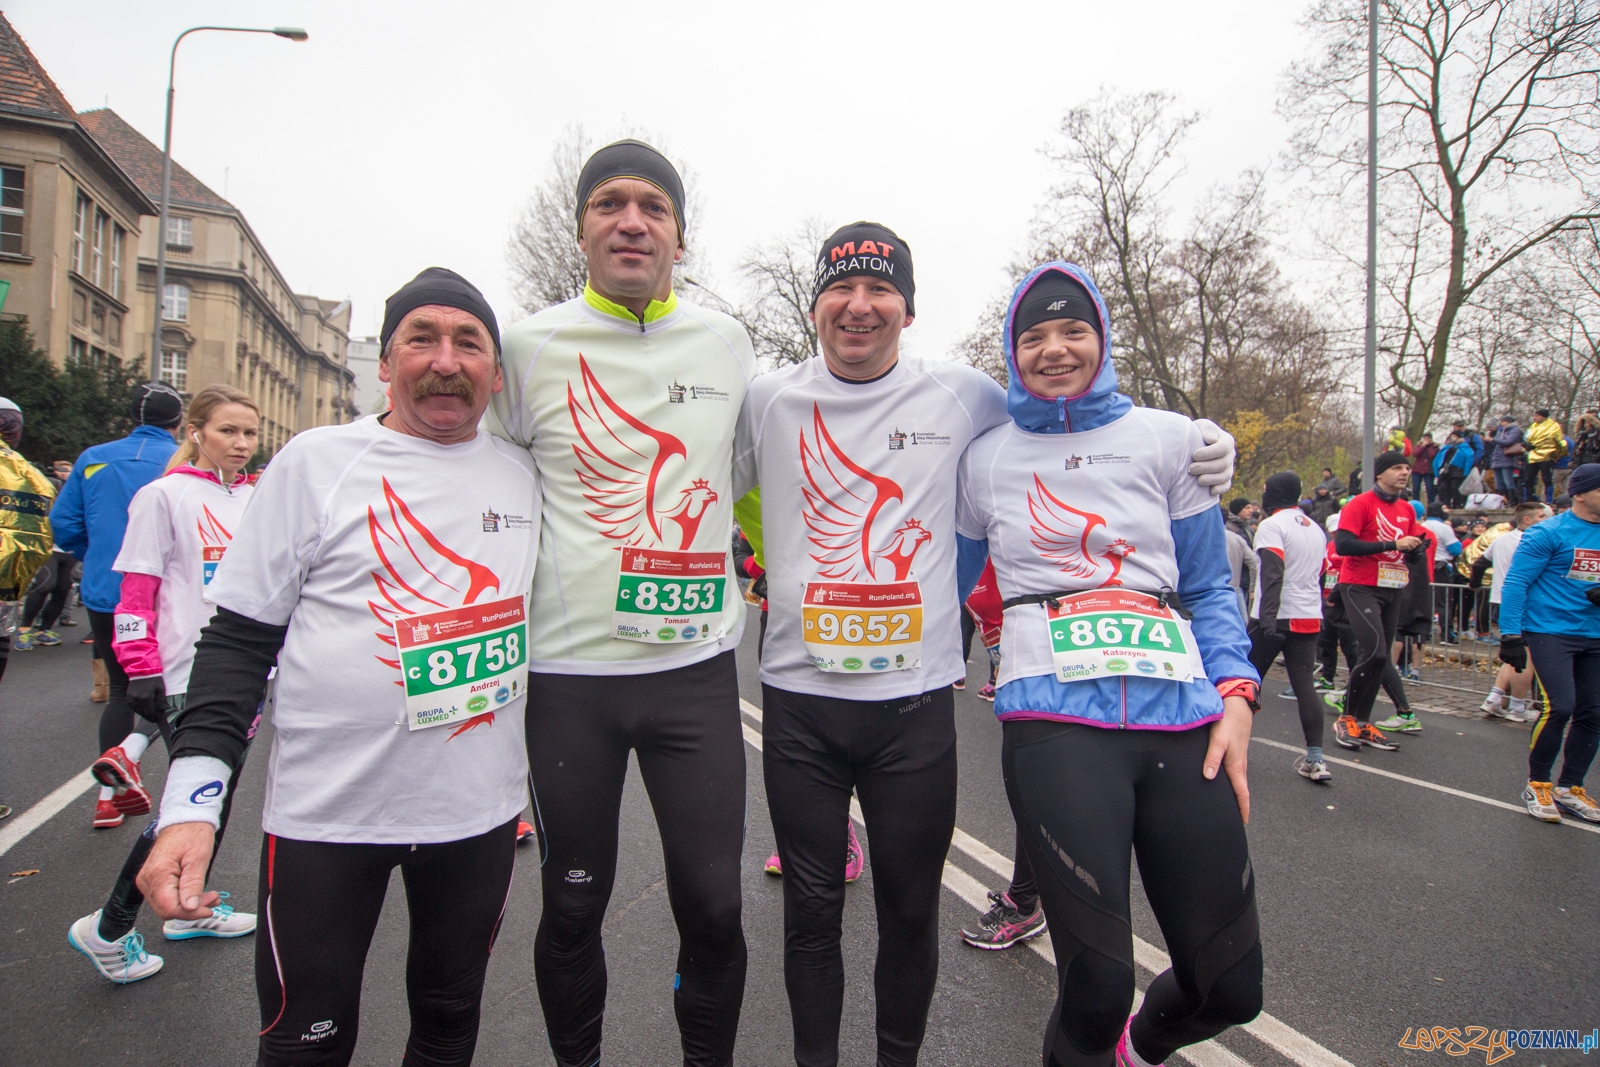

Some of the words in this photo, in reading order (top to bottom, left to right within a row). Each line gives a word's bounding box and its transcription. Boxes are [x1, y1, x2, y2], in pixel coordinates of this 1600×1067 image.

[831, 240, 894, 262] MAT
[689, 562, 721, 570] RunPoland.org
[634, 581, 716, 612] 8353
[868, 592, 915, 601] RunPoland.org
[1119, 599, 1164, 615] RunPoland.org
[481, 608, 521, 624] RunPoland.org
[617, 630, 642, 638] LUXMED
[817, 612, 911, 643] 9652
[1069, 617, 1172, 648] 8674
[427, 632, 520, 686] 8758
[1102, 650, 1147, 658] Katarzyna
[1062, 664, 1085, 672] GRUPA
[1063, 670, 1090, 679] LUXMED
[470, 678, 500, 694] Andrzej
[417, 707, 444, 718] GRUPA
[898, 700, 921, 715] super
[922, 694, 932, 705] fit
[417, 713, 449, 725] LUXMED
